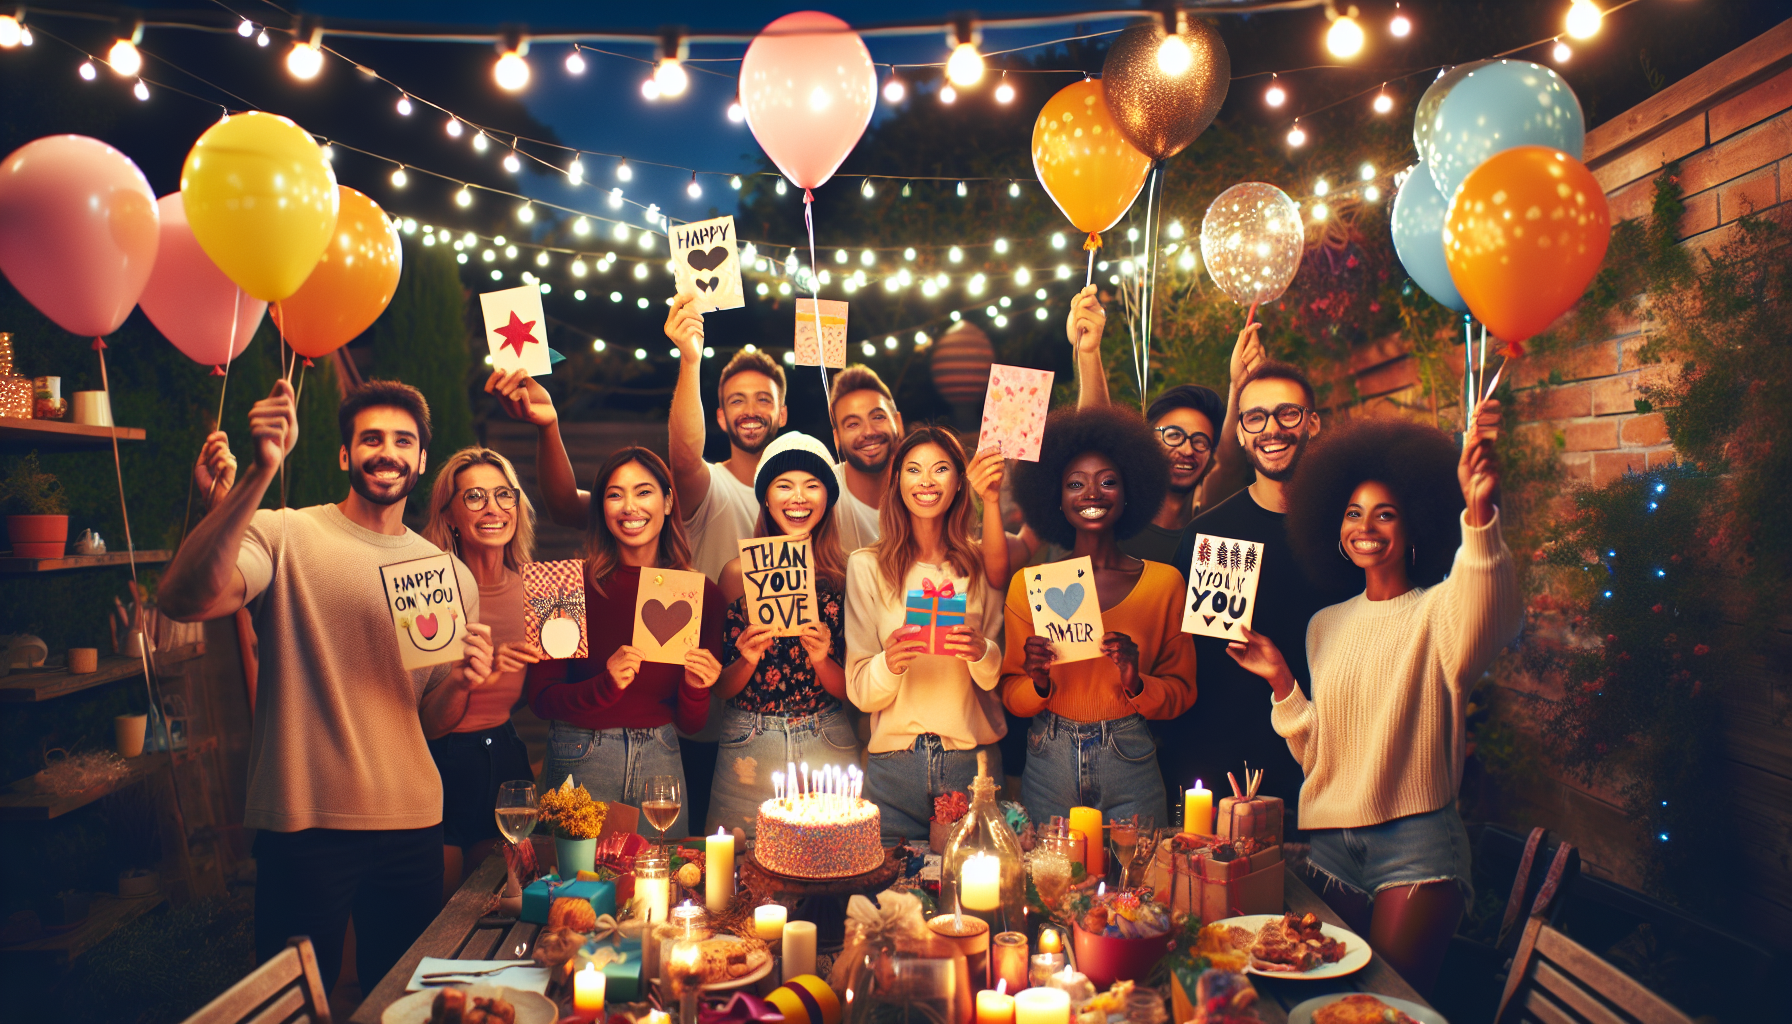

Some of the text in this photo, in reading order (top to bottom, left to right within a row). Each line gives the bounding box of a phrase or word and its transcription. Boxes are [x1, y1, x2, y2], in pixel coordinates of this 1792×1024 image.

[677, 223, 730, 249] HAPPY
[742, 541, 807, 571] THAN
[393, 568, 445, 592] HAPPY
[744, 569, 807, 601] YOU!
[394, 587, 453, 612] ON YOU
[758, 595, 811, 629] OVE
[1191, 586, 1247, 619] YOU
